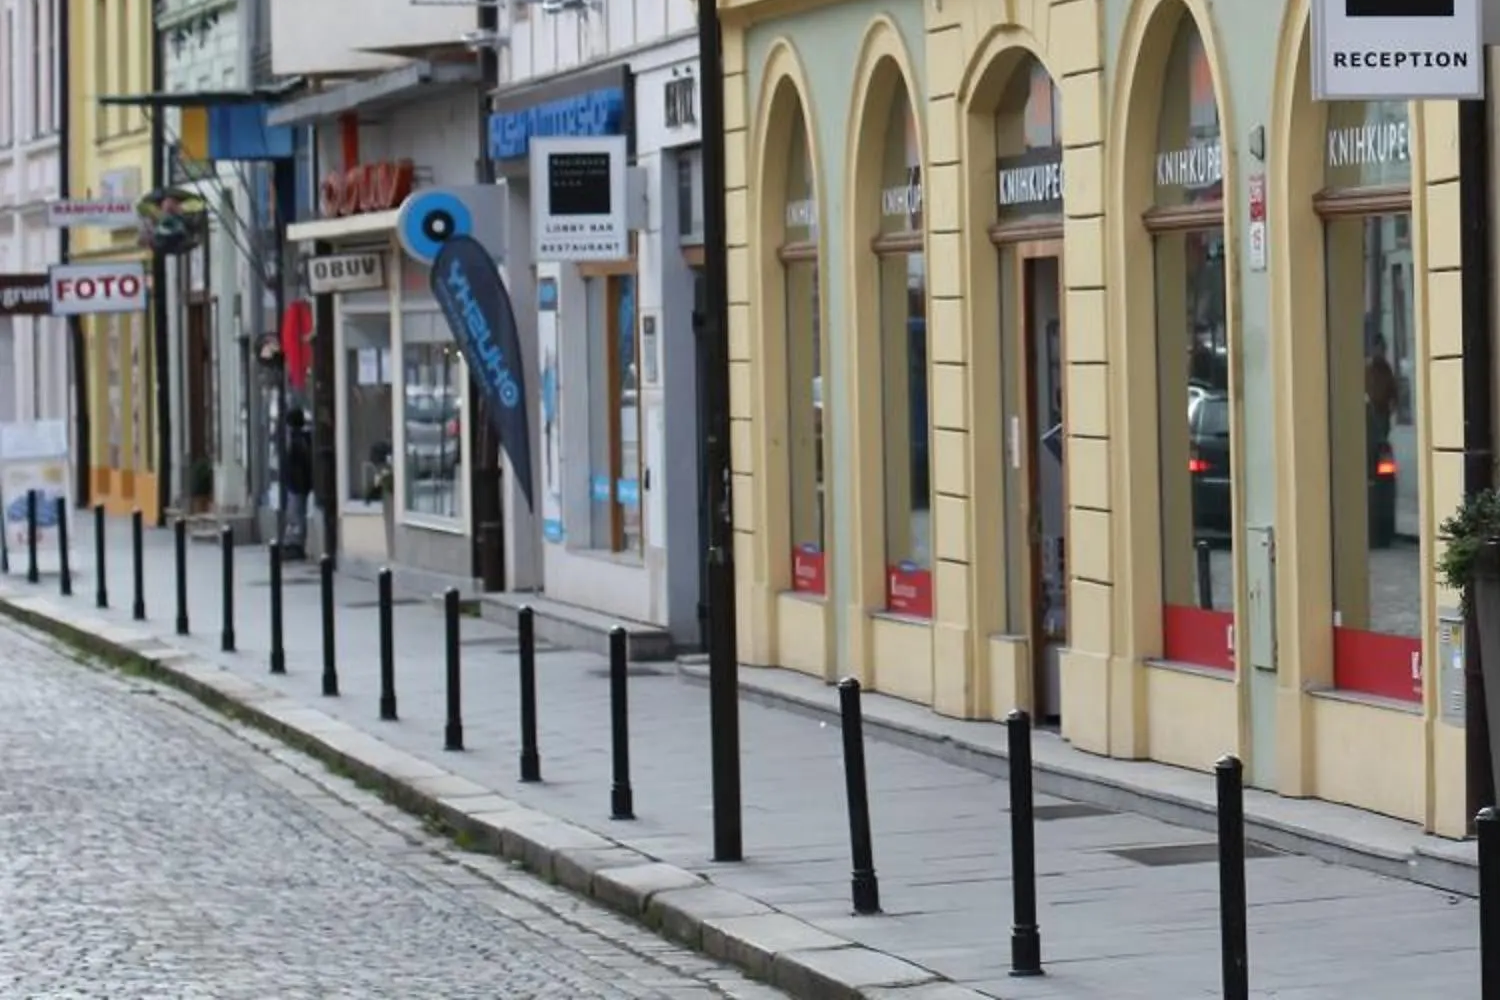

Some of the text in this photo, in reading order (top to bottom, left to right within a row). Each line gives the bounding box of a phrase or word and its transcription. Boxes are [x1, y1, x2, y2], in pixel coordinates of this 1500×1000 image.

[1332, 50, 1469, 69] RECEPTION
[314, 256, 376, 280] OBUV
[56, 274, 140, 302] FOTO
